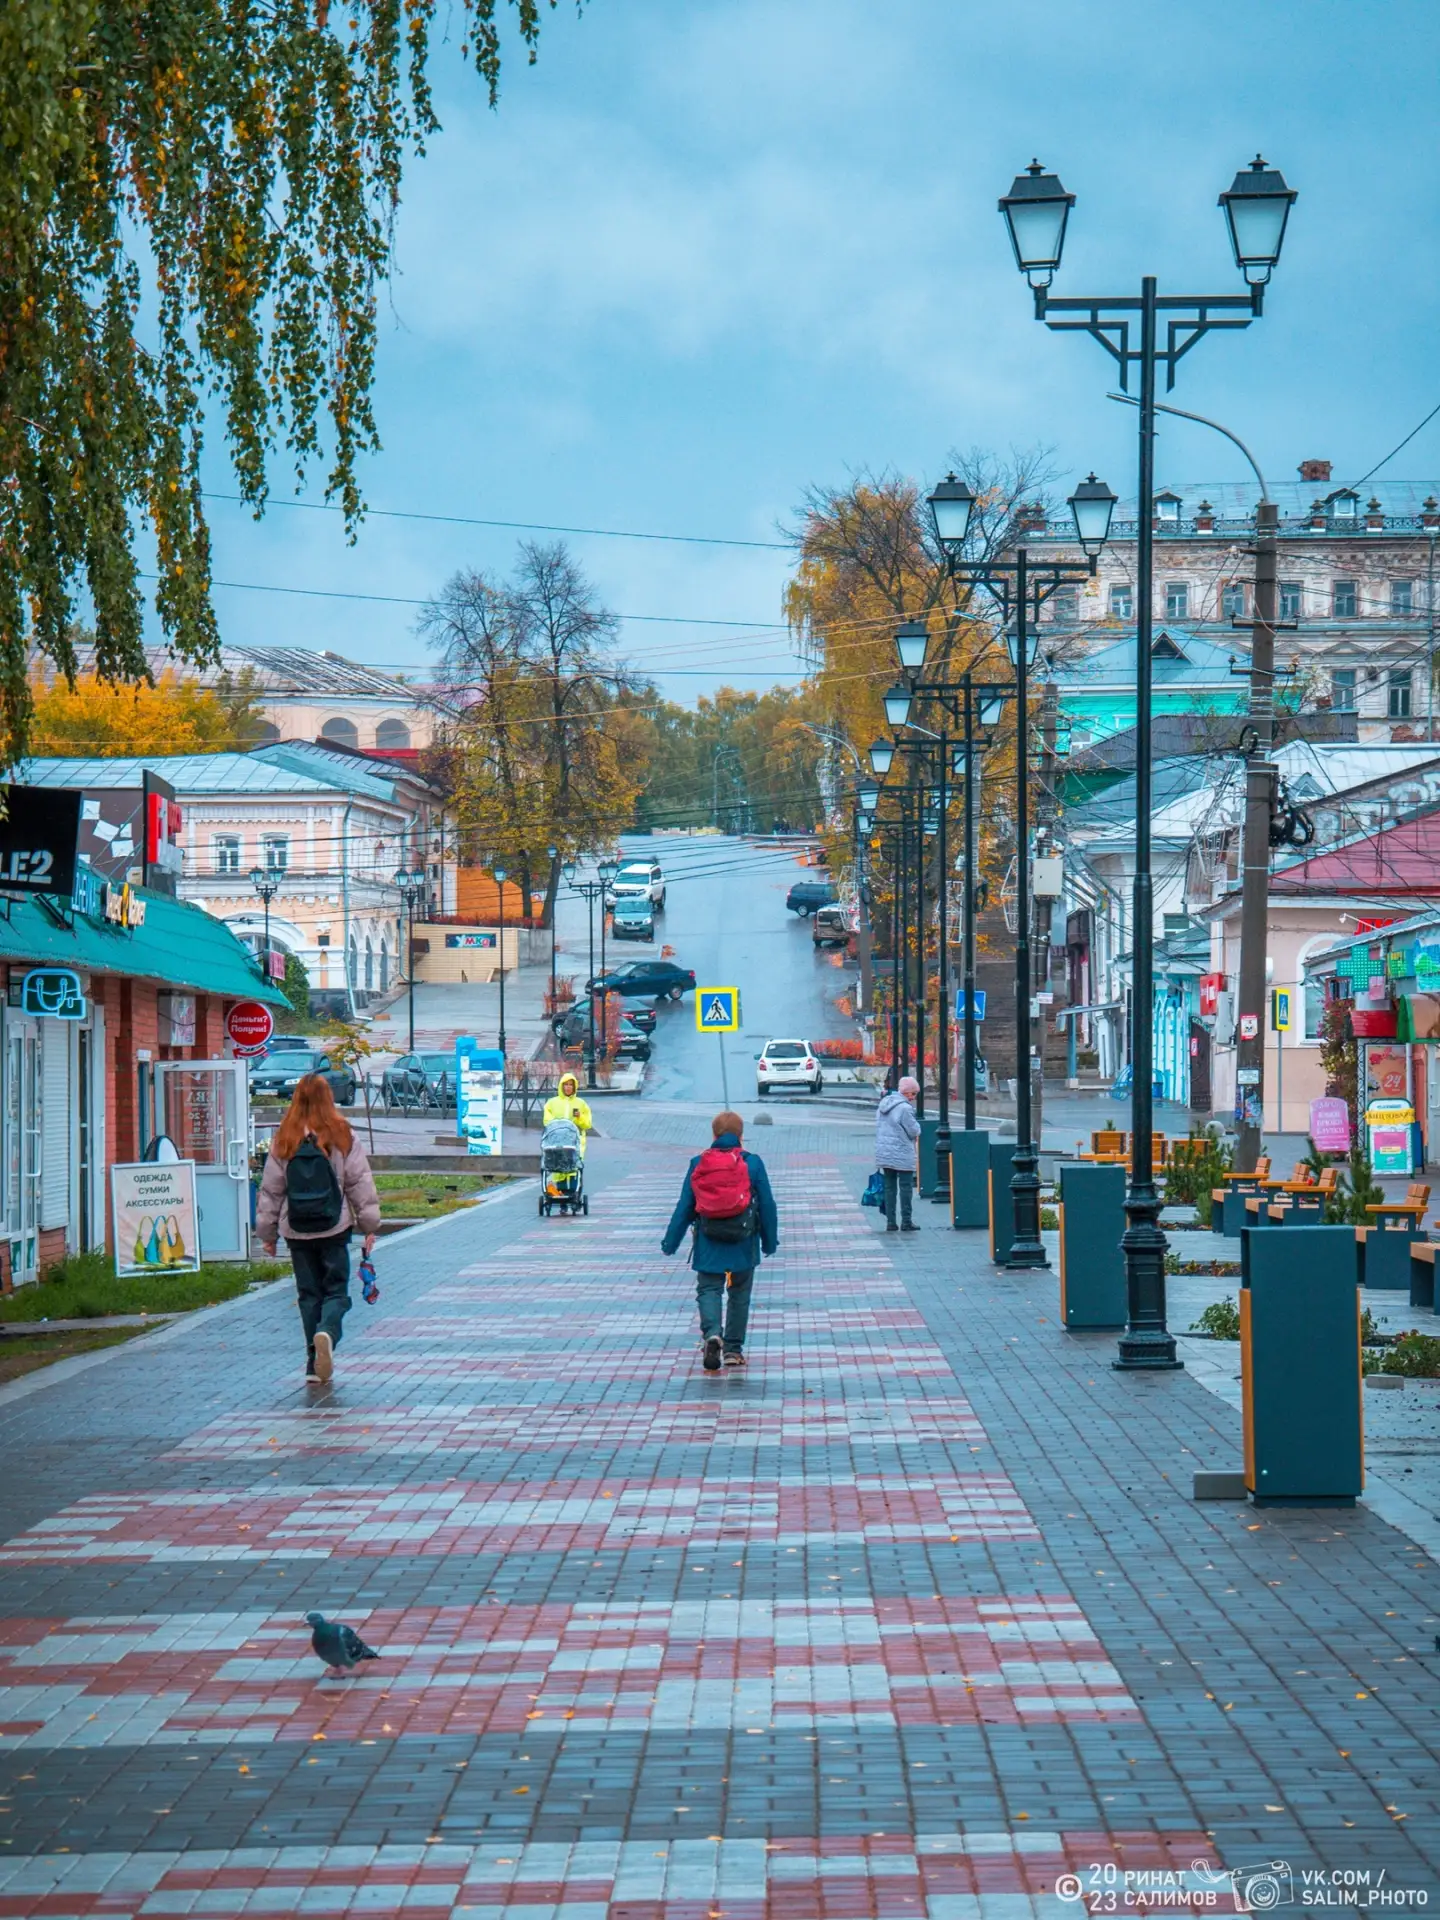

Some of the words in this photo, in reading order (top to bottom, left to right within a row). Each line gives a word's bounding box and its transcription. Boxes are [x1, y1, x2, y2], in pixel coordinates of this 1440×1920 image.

[231, 1014, 268, 1024] Деньги?
[231, 1024, 267, 1034] Получи!
[1383, 1074, 1402, 1088] 24
[133, 1173, 173, 1184] ОДЕЖДА
[138, 1186, 170, 1195] СУМКИ
[126, 1197, 184, 1208] АКСЕССУАРЫ
